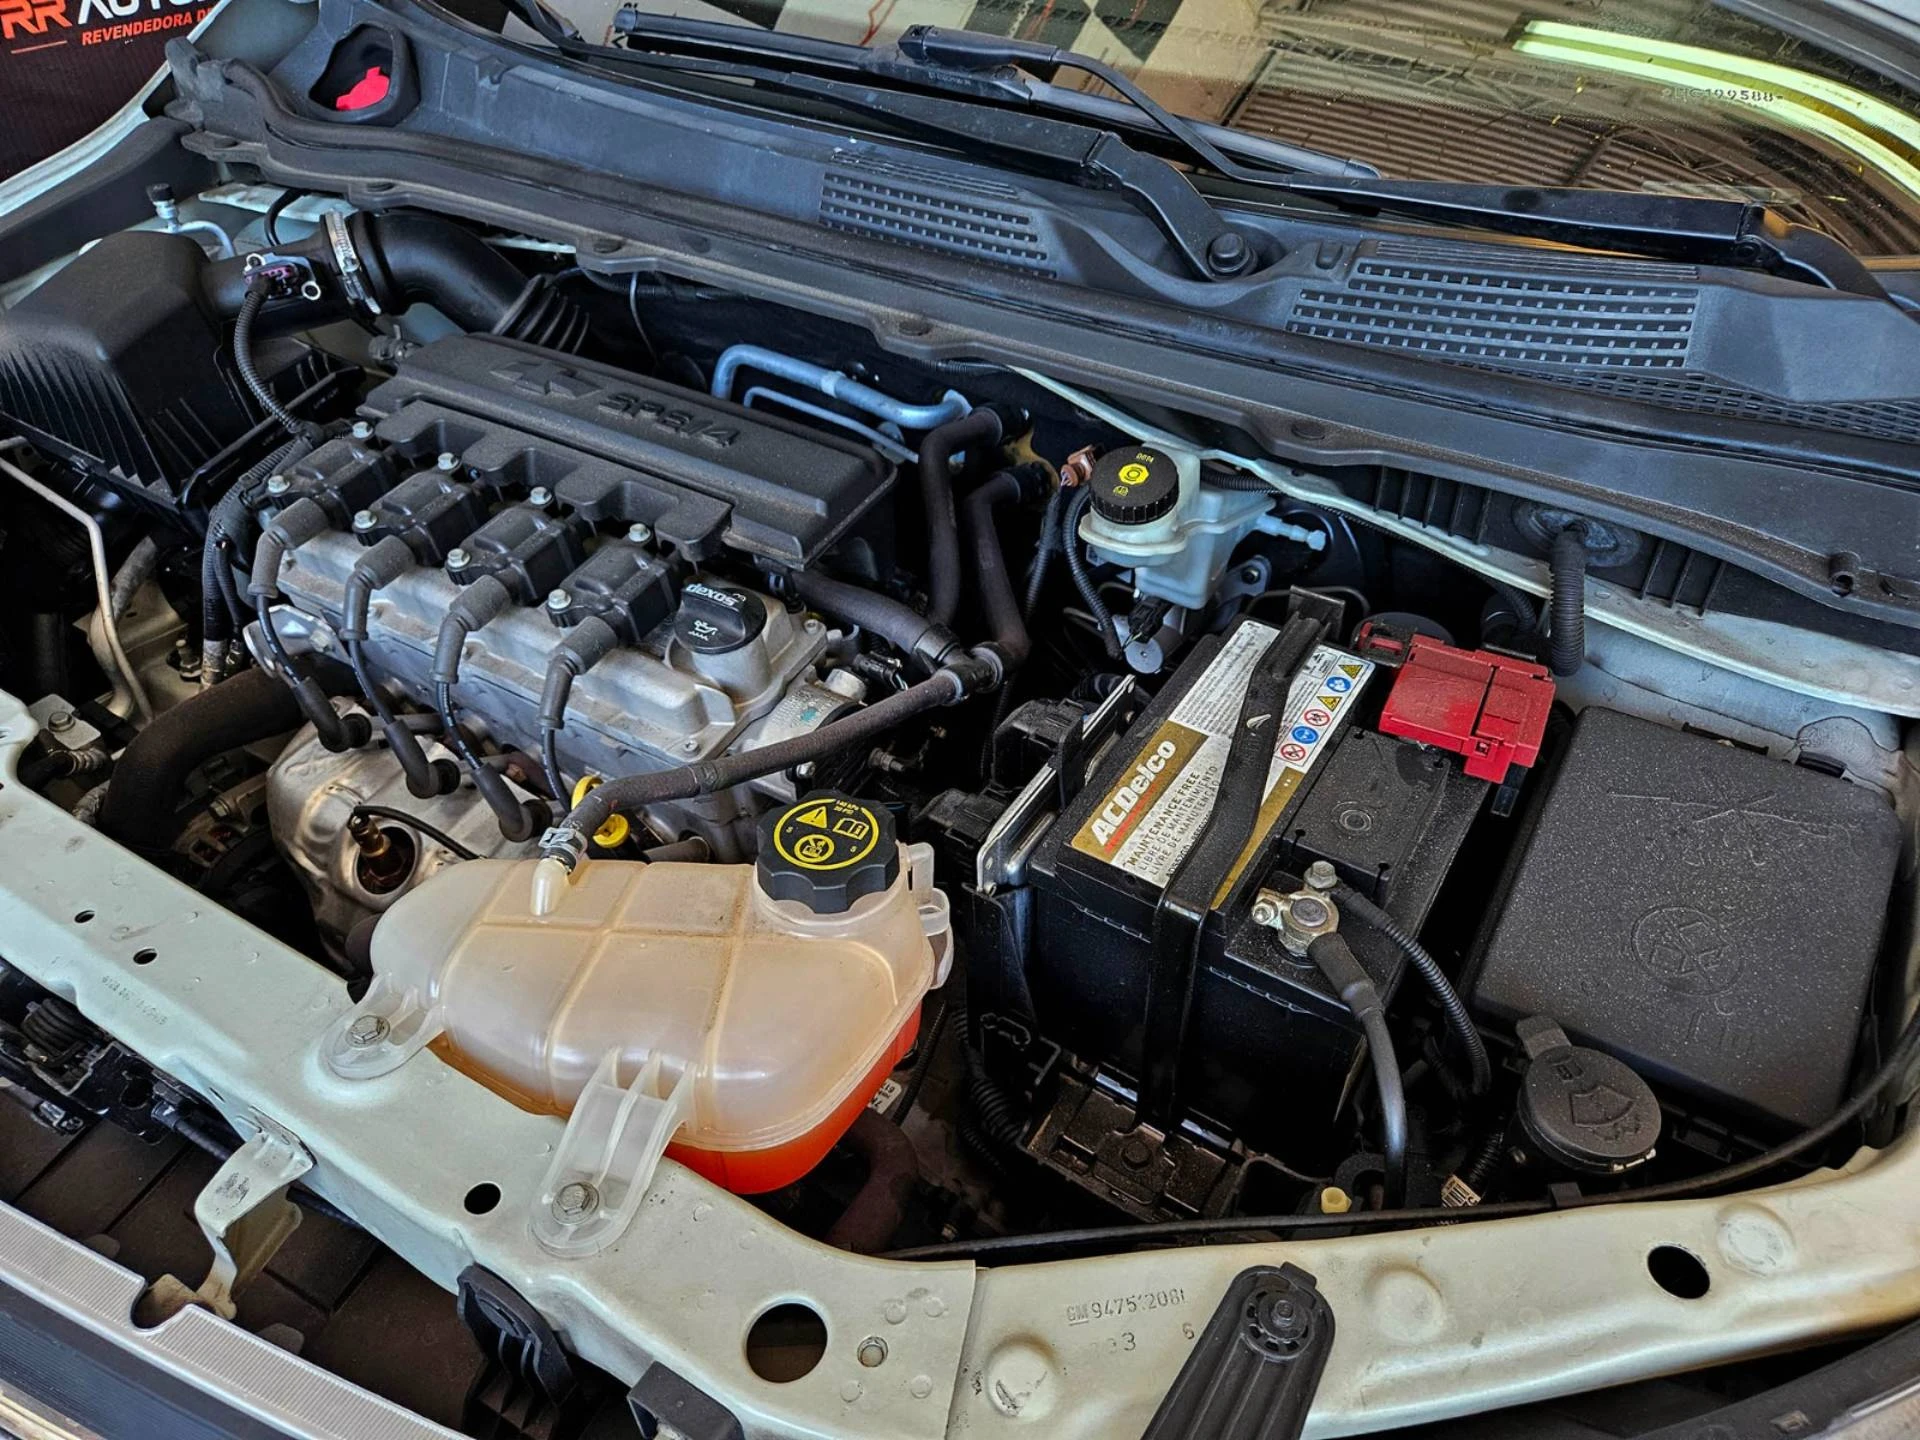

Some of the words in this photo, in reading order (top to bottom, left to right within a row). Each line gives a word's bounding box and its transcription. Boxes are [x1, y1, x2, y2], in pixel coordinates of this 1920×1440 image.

[81, 11, 193, 46] REVENDEDORA
[196, 8, 213, 23] D
[685, 583, 739, 607] dexos
[1091, 740, 1177, 846] ACDelco
[1127, 797, 1180, 866] MAINTENANCE
[1178, 772, 1200, 796] FREE
[1139, 845, 1160, 871] LIBRE
[1158, 831, 1170, 845] DE
[1169, 765, 1218, 831] MANTENIMIENTO
[1149, 850, 1172, 876] LIVRE
[1167, 835, 1181, 848] DE
[1179, 779, 1220, 835] MANUTENÇÃO
